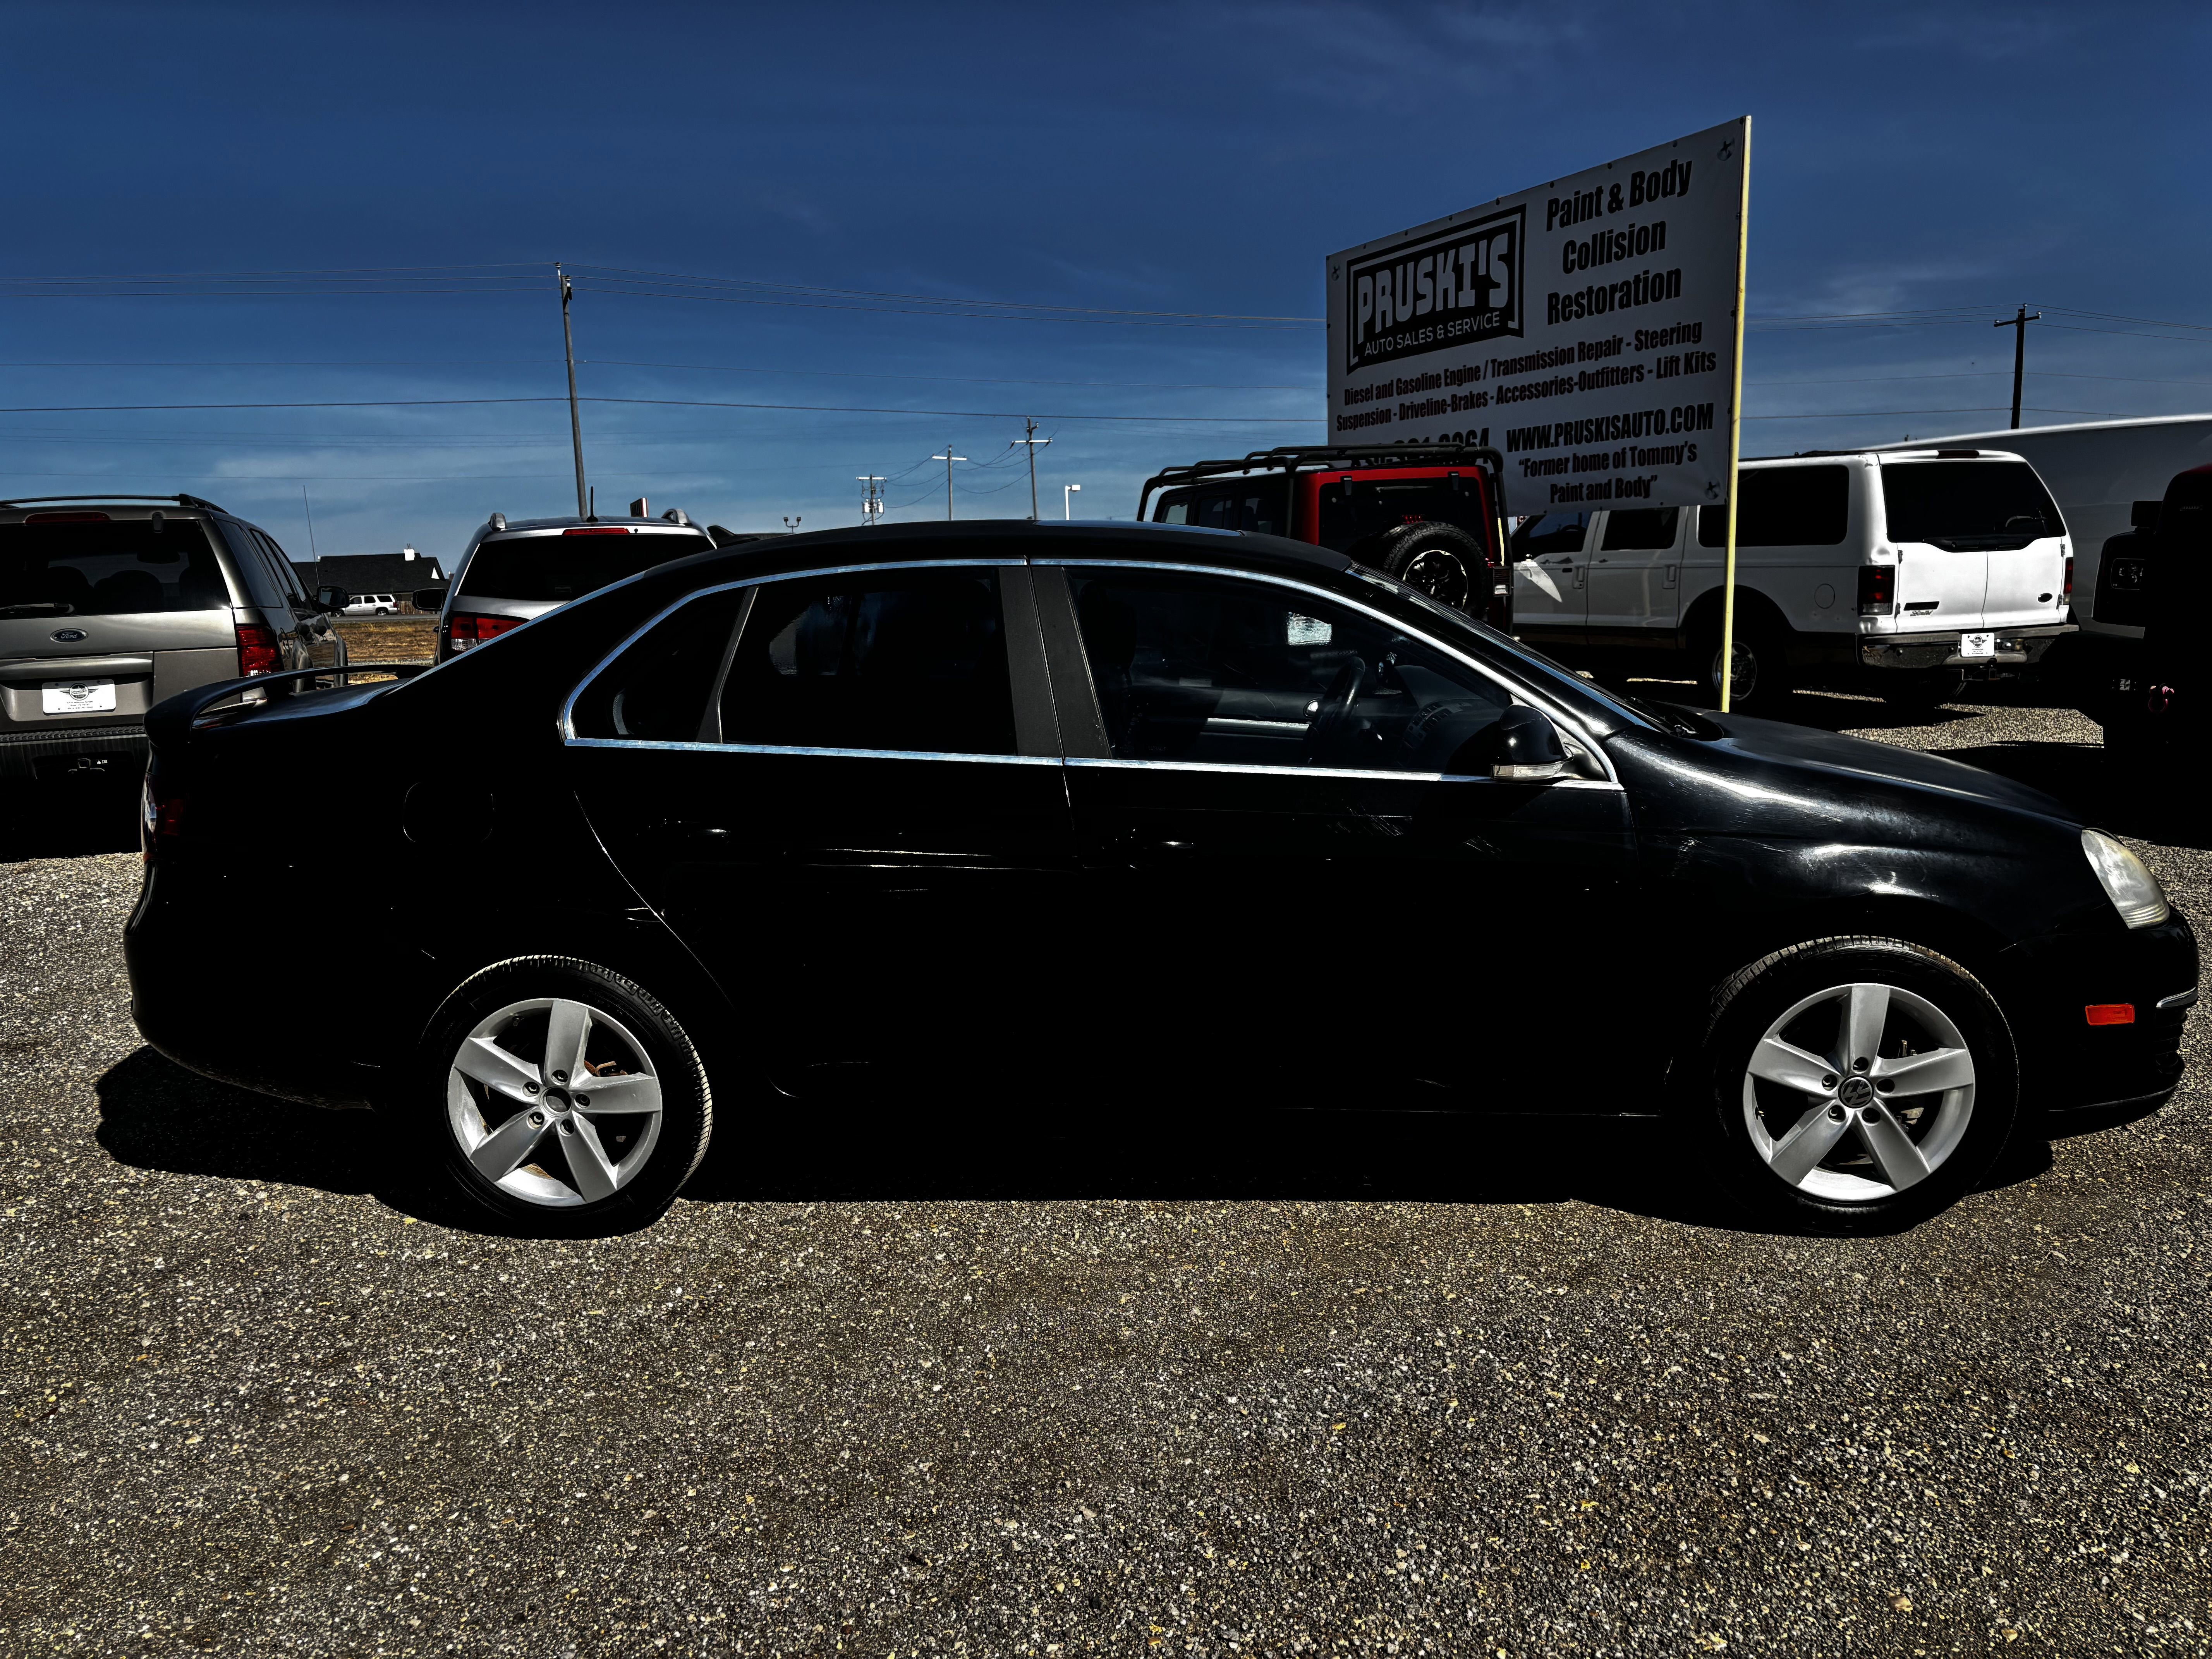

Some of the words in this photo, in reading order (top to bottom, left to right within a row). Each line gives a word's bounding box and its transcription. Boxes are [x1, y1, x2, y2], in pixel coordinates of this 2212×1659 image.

[1547, 186, 1603, 231] Paint
[1607, 183, 1624, 213] &
[1630, 159, 1692, 207] Body
[1563, 221, 1666, 274] Collision
[1358, 233, 1508, 344] PRUSKI'S
[1548, 268, 1681, 325] Restoration
[1364, 337, 1394, 356] AUTO
[1396, 327, 1433, 349] SALES
[1437, 325, 1445, 339] &
[1447, 311, 1500, 337] SERVICE
[1337, 407, 1391, 431] Suspension
[1399, 391, 1488, 421] Driveline-Brakes
[1496, 364, 1644, 404] Accessories-Outfitters
[1656, 355, 1680, 379] Lift
[1684, 351, 1716, 375] Kits
[1345, 384, 1373, 405] Diesel
[1376, 380, 1393, 400] and
[1396, 373, 1442, 396] Gasoline
[1444, 365, 1480, 387] Engine
[1483, 360, 1489, 380] /
[1491, 350, 1575, 378] Transmission
[1578, 335, 1623, 362] Repair
[1635, 322, 1702, 351] Steering
[1506, 402, 1714, 452] WWW.PRUSKISAUTO.COM
[1573, 453, 1609, 472] home
[1613, 448, 1626, 469] of
[1630, 441, 1697, 467] Tommy’s
[1551, 479, 1583, 503] Paint
[1587, 479, 1612, 501] and
